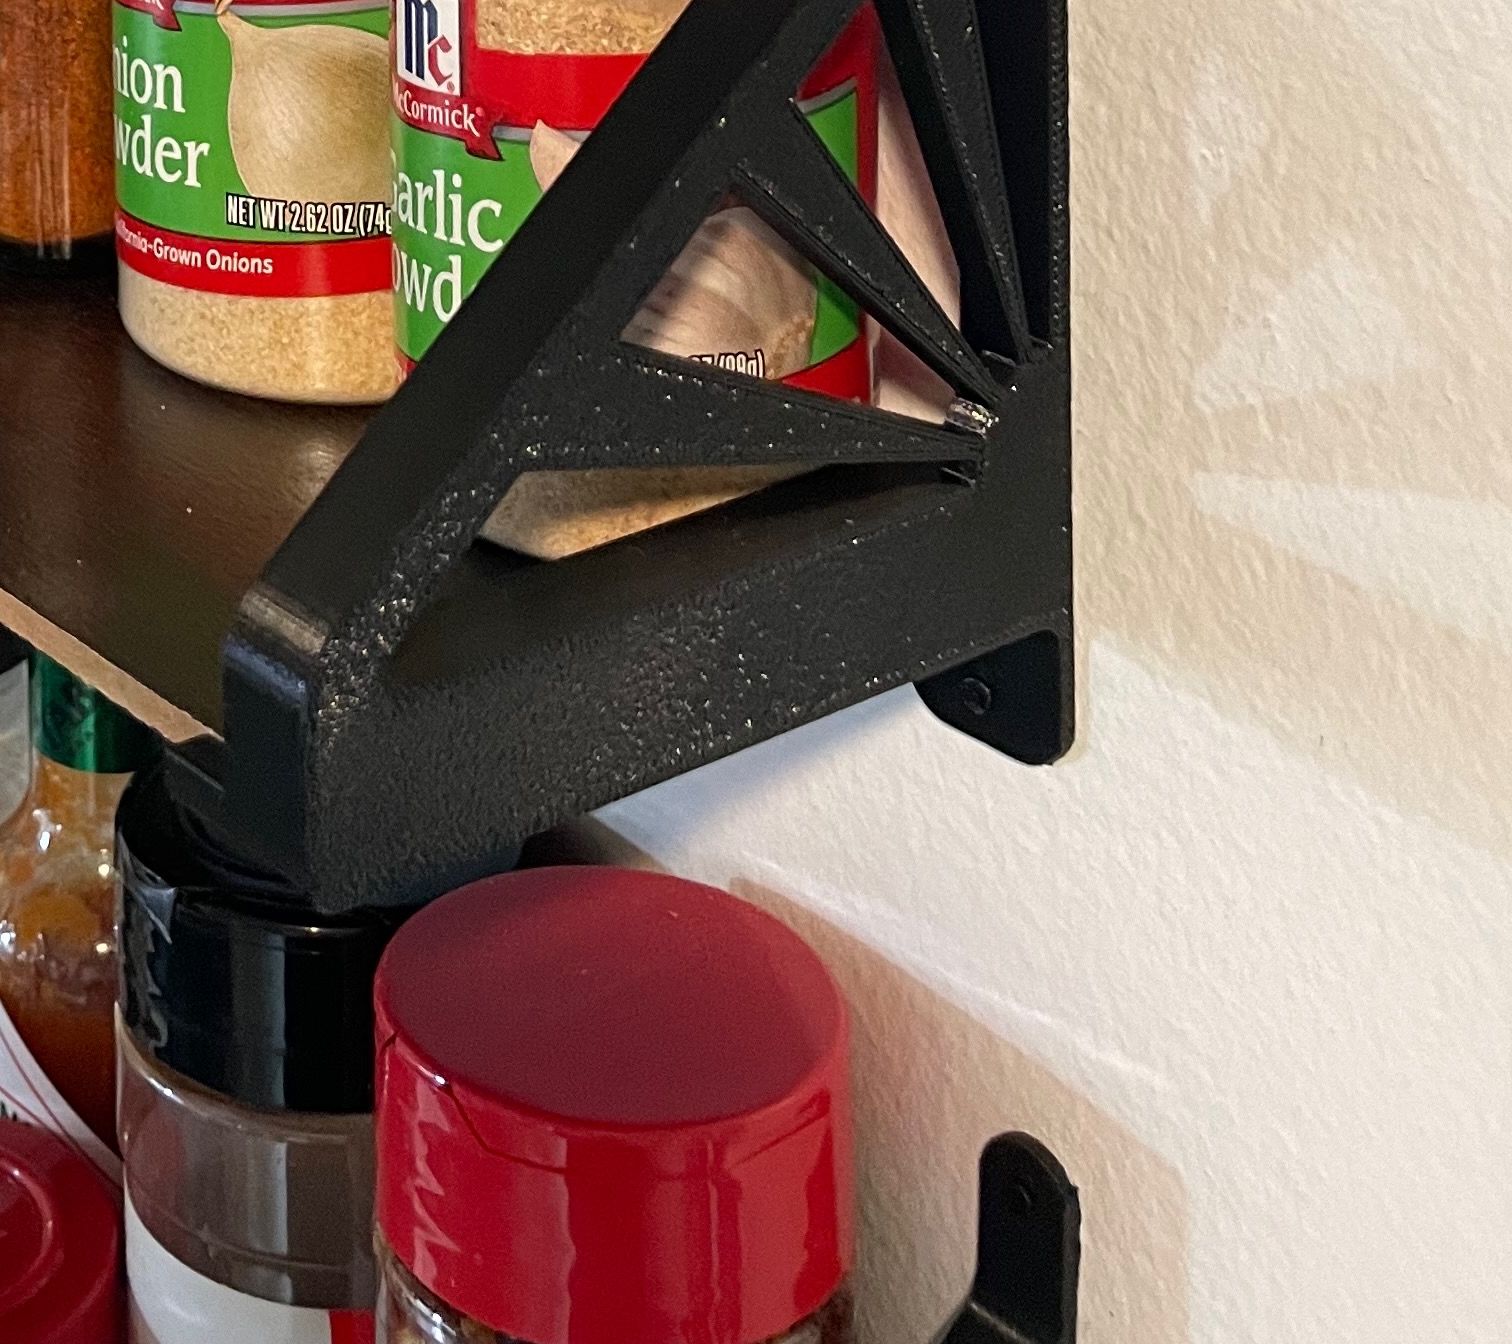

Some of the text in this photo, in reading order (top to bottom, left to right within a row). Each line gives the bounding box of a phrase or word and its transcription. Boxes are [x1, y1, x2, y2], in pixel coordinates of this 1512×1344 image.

[227, 194, 255, 226] NET
[259, 199, 286, 231] WT
[290, 202, 327, 233] 2.62
[332, 203, 356, 234] OZ
[390, 169, 504, 253] arlic
[206, 249, 273, 274] Onions
